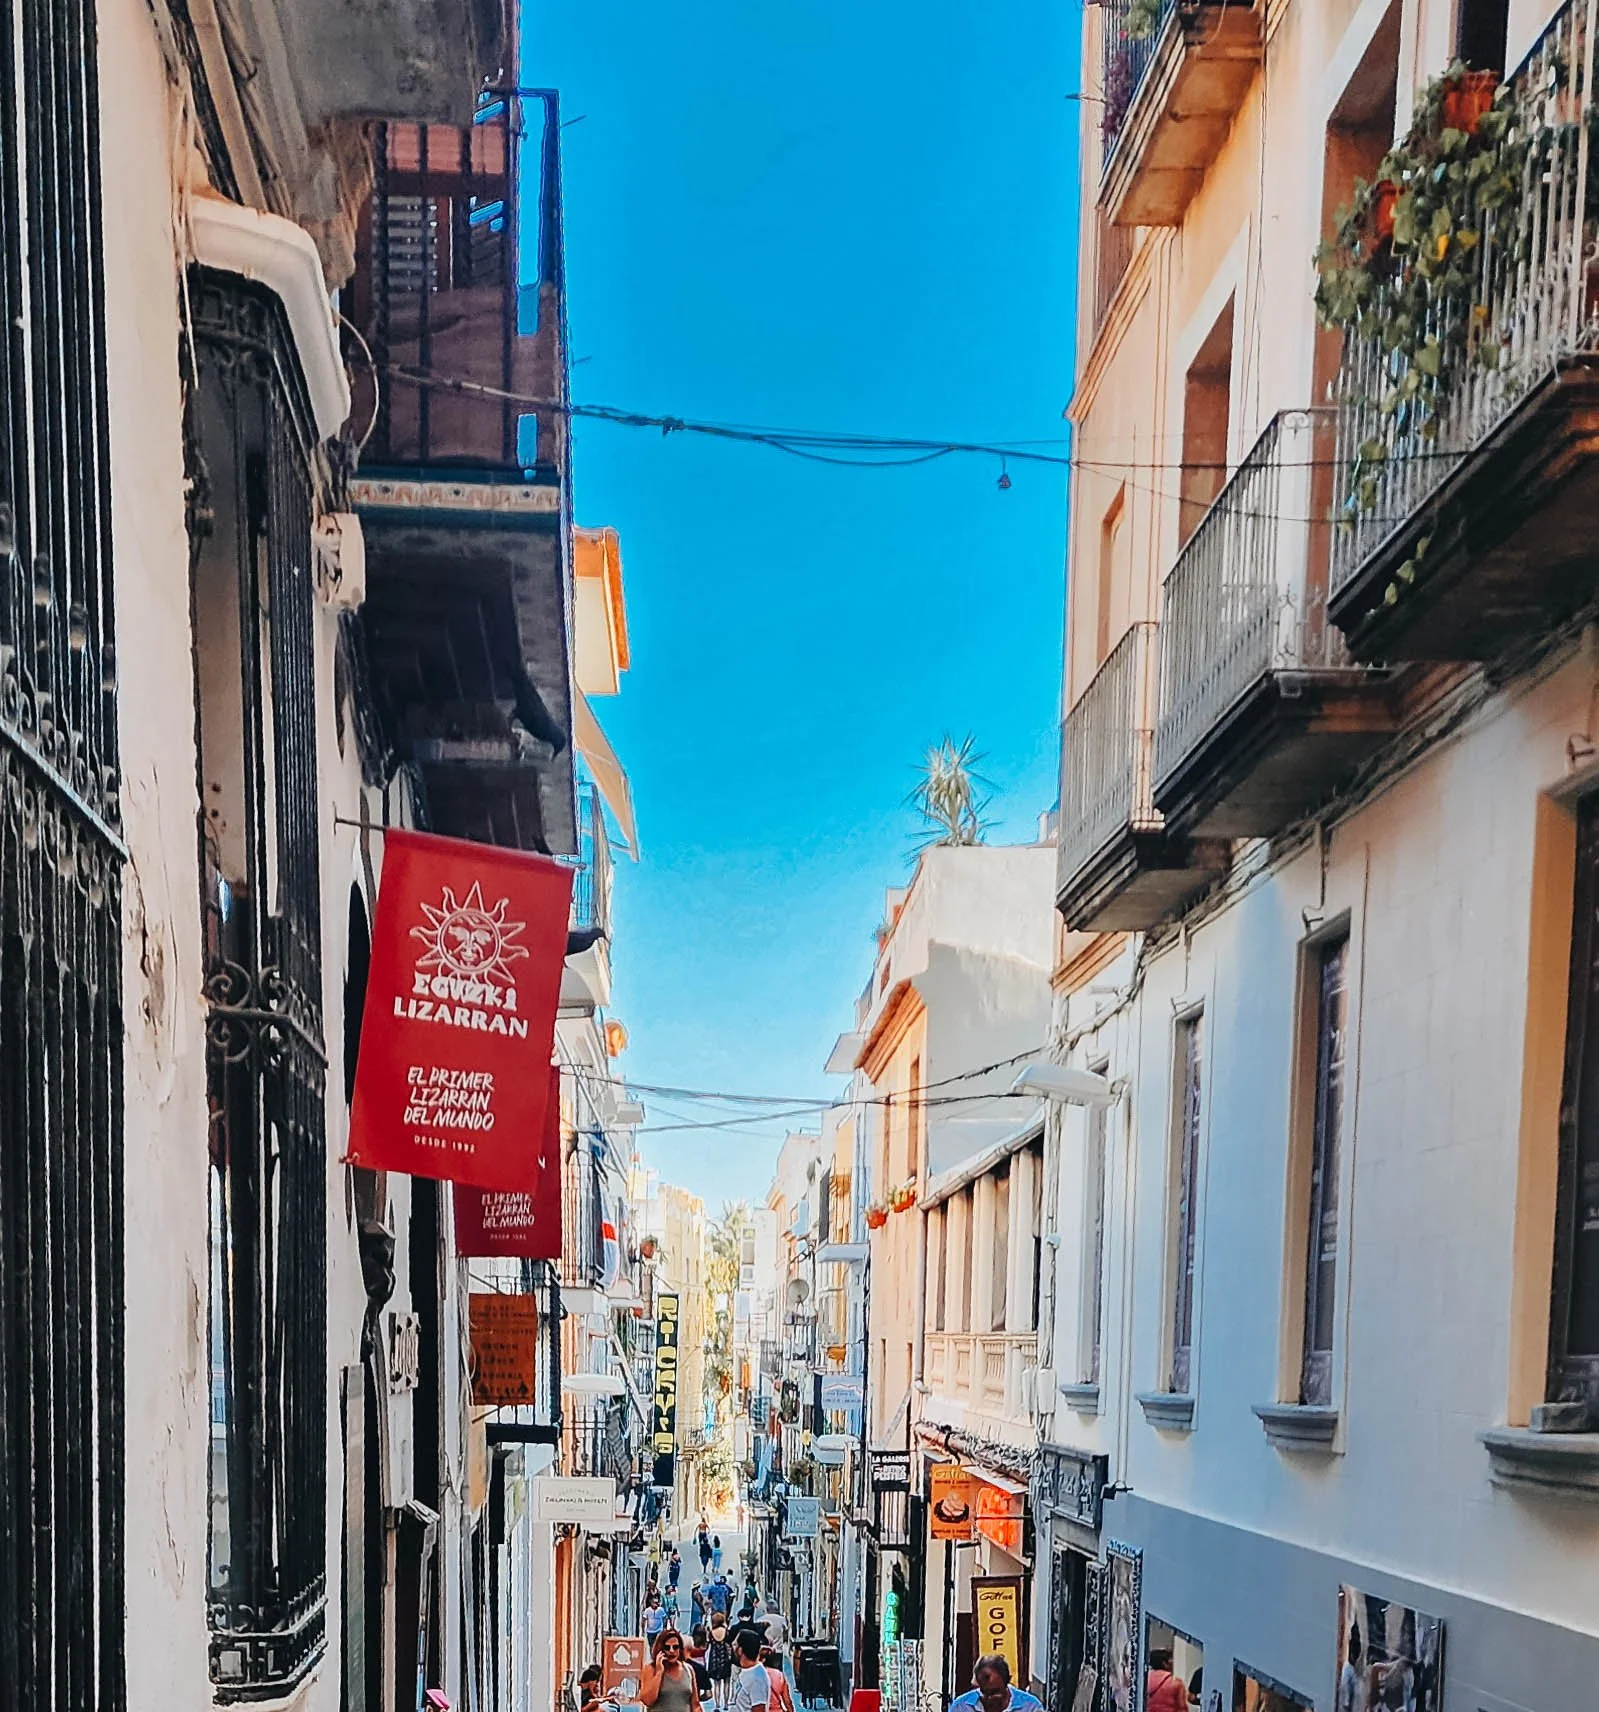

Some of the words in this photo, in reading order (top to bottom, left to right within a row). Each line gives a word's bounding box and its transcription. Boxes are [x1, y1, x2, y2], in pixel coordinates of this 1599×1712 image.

[393, 996, 528, 1039] LIZARRAN
[407, 1066, 428, 1086] EL
[429, 1066, 495, 1091] PRIMER
[410, 1086, 491, 1111] LIZARRAN
[403, 1105, 431, 1125] DEL
[432, 1108, 495, 1131] MUNDO
[414, 1134, 446, 1149] DESDE
[485, 1202, 531, 1217] LIZARRAN
[500, 1214, 535, 1228] MUNDO
[988, 1607, 1006, 1659] GOF
